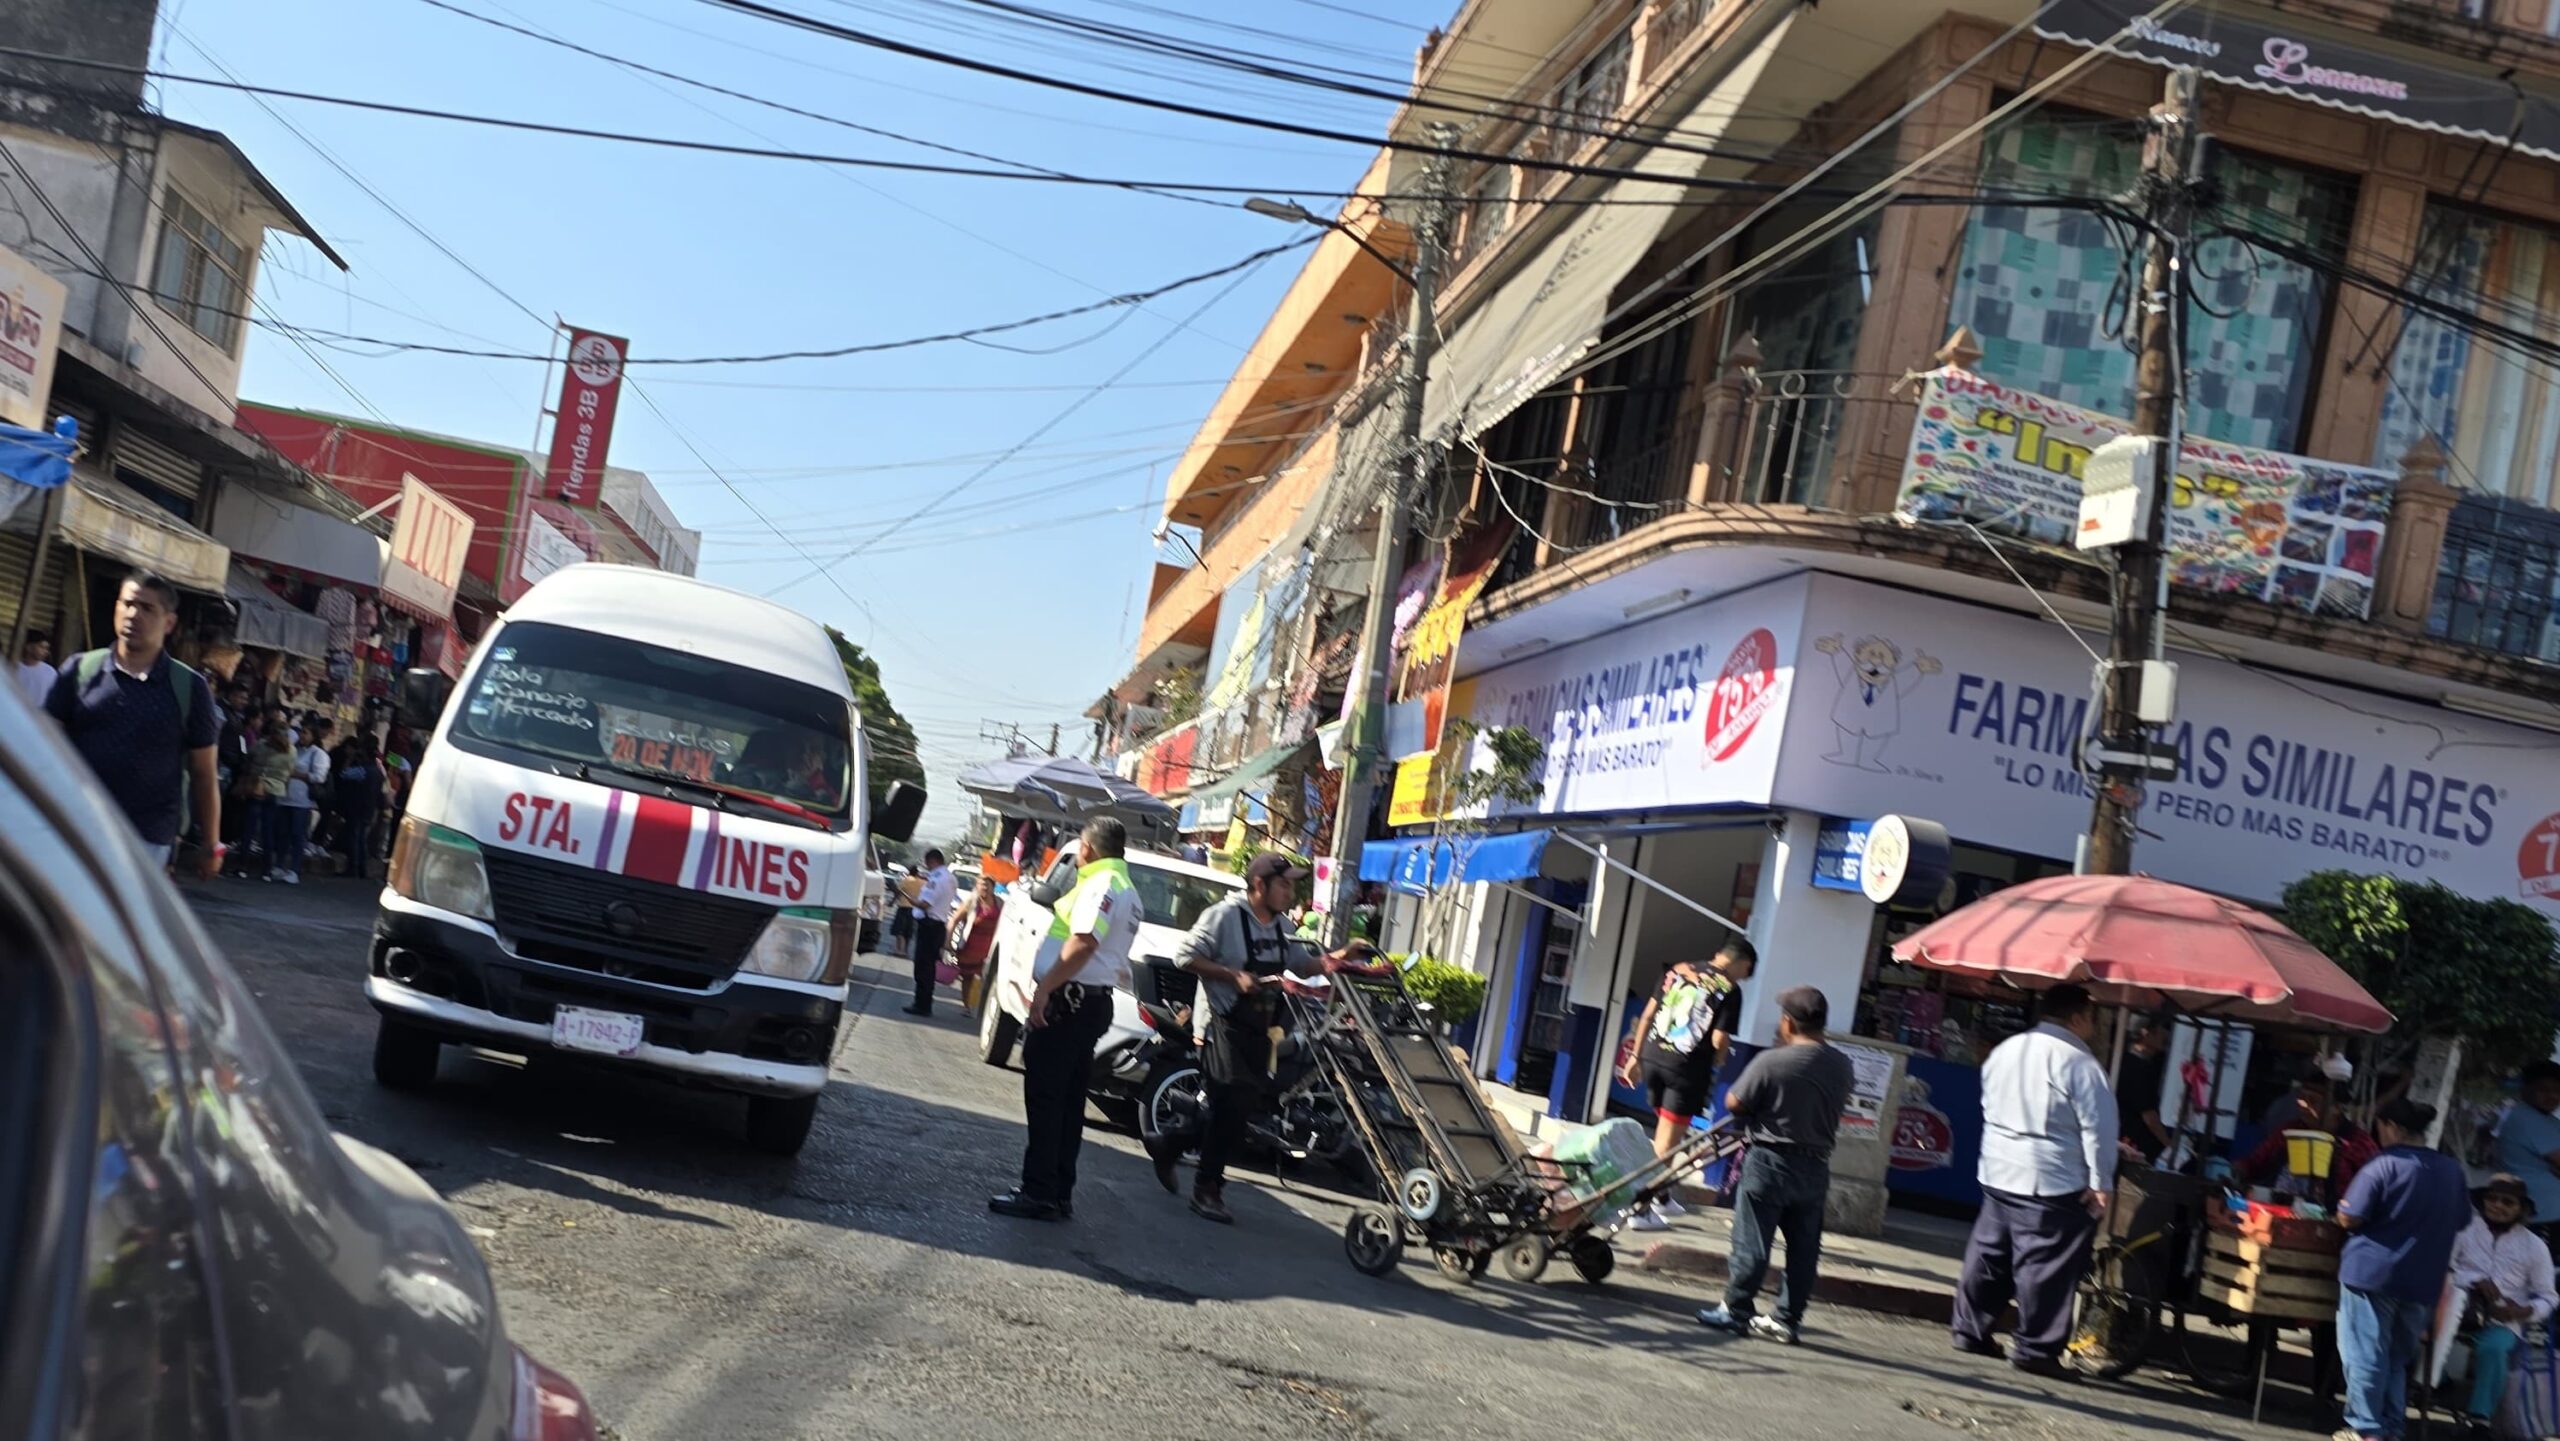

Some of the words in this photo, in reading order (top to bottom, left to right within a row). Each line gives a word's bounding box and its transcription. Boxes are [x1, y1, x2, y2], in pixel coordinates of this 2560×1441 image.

[577, 388, 599, 421] 3B
[404, 492, 463, 588] LUX
[495, 698, 594, 730] Mercado
[2155, 790, 2235, 829] PERO
[2241, 807, 2304, 841] MAS
[2241, 733, 2498, 848] SIMILARES
[498, 791, 581, 855] STA.
[714, 835, 810, 902] INES
[1896, 1119, 1937, 1150] 5%
